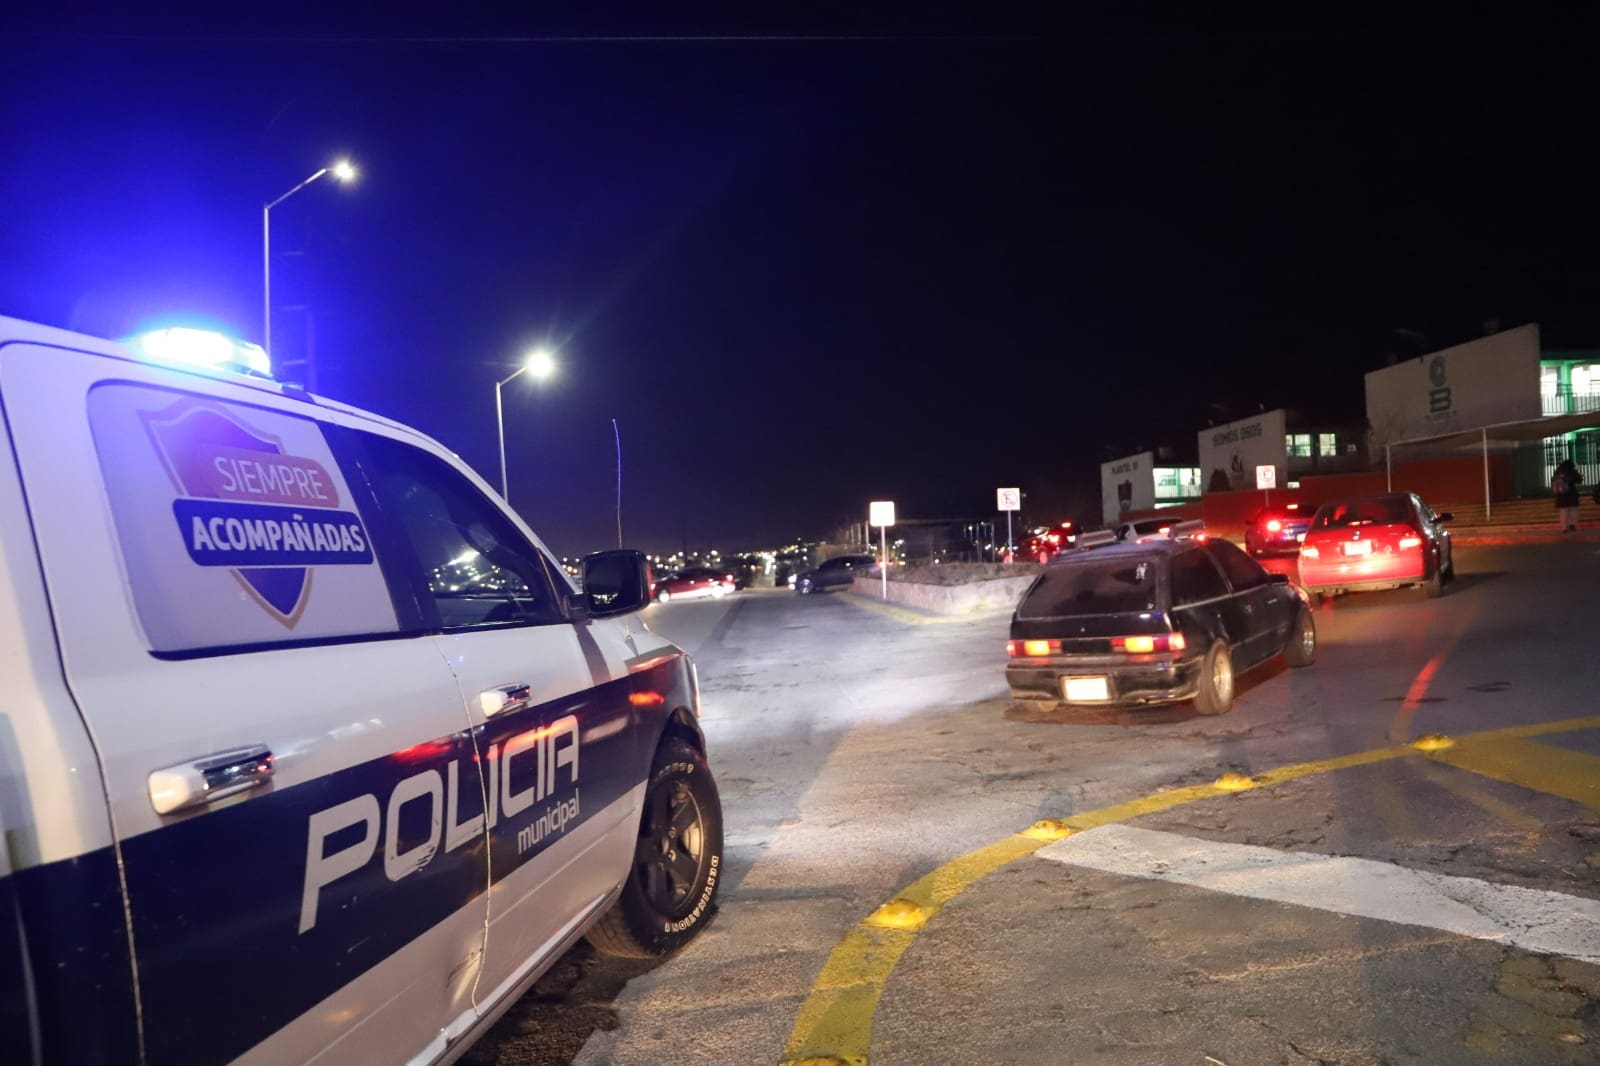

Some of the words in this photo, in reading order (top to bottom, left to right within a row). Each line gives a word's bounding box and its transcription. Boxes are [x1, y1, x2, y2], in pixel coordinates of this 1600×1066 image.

[214, 456, 328, 500] SIEMPRE
[192, 513, 366, 553] ACOMPAÑADAS
[298, 714, 580, 935] POLICIA
[517, 788, 580, 856] municipal
